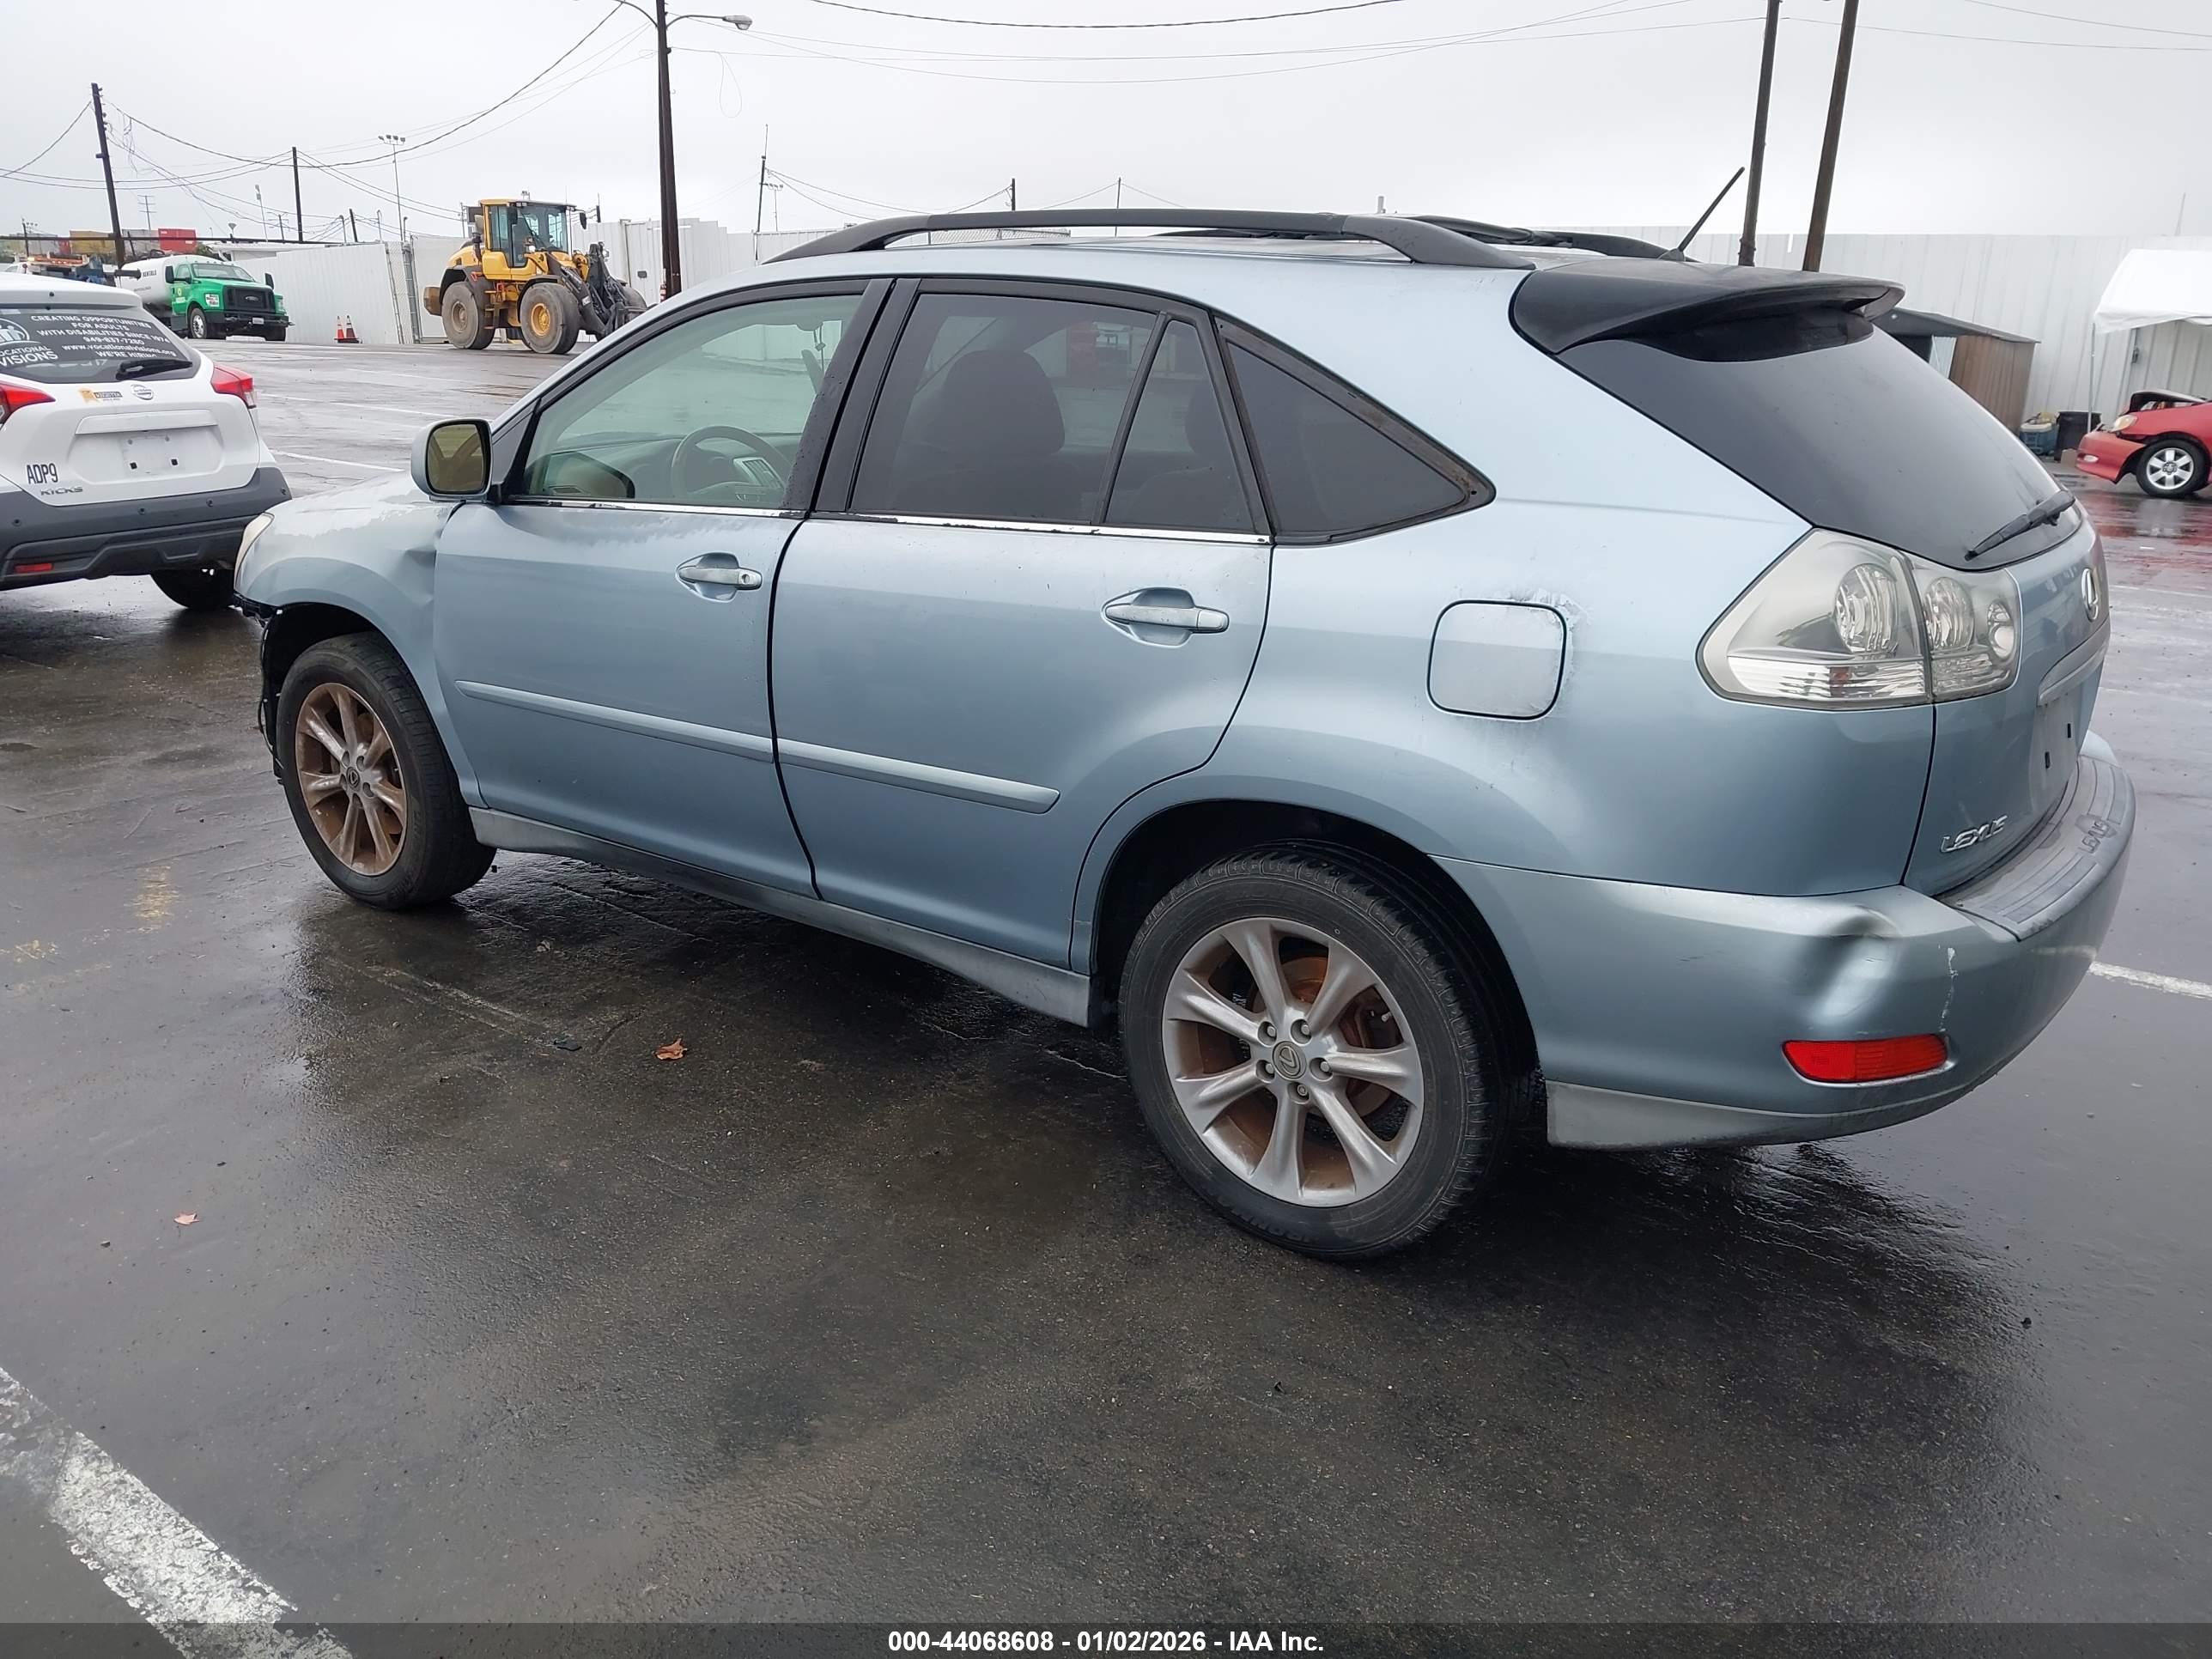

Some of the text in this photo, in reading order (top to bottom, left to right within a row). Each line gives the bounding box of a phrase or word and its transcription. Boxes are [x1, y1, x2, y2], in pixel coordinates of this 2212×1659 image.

[82, 316, 151, 329] OPPORTUNITIES
[125, 331, 151, 340] SINCE
[0, 345, 52, 357] OCATIONAL
[27, 463, 58, 483] ADP9
[40, 486, 83, 495] KICKS
[1941, 815, 2008, 853] LEXUS
